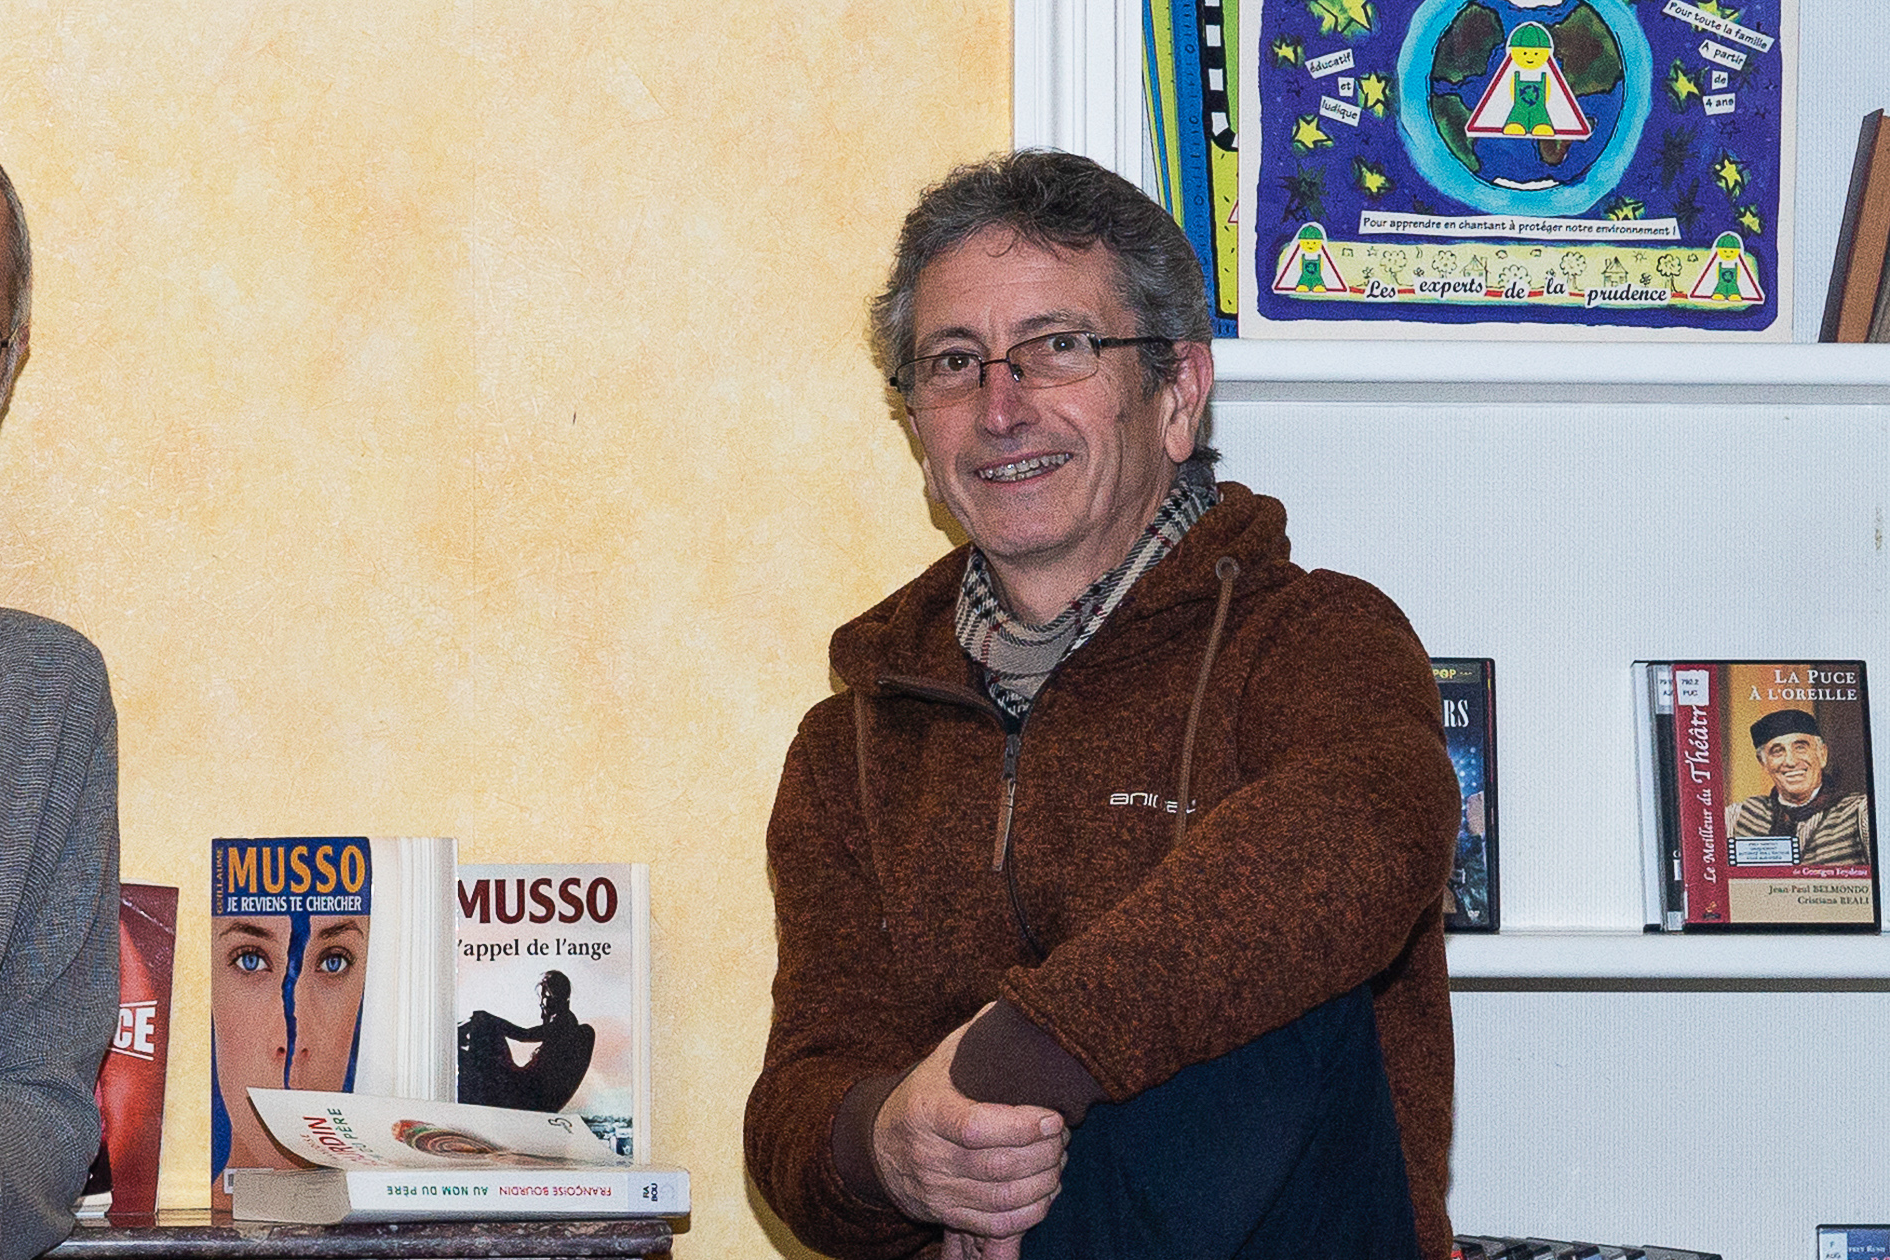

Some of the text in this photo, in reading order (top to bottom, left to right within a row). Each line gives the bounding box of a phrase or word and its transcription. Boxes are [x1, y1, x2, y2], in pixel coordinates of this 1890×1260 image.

[1669, 1, 1768, 50] Pour toute la famille
[1310, 52, 1351, 73] éducatif
[1713, 48, 1744, 65] partir
[1340, 82, 1352, 91] et
[1714, 74, 1727, 84] de
[1322, 99, 1358, 119] ludique
[1363, 217, 1387, 228] Pour
[1389, 218, 1441, 231] apprendre
[1444, 221, 1456, 229] en
[1459, 219, 1507, 230] chantant
[1509, 220, 1516, 230] à
[1518, 221, 1563, 234] protéger
[1565, 223, 1593, 233] notre
[1596, 225, 1671, 236] environnement
[1366, 278, 1667, 305] Les experts de la prudence
[1774, 669, 1857, 684] LA PUCE
[1749, 685, 1858, 701] À L'OREILLE
[1685, 704, 1717, 884] Le Meilleur du Théâtr
[227, 845, 366, 894] MUSSO
[1812, 885, 1869, 894] BELMONDO
[227, 895, 362, 913] JE REVIENS TE CHERCHER
[457, 876, 619, 925] MUSSO
[457, 938, 612, 962] 'appel de l'ange
[386, 1184, 612, 1198] FRANÇOISE BOURDIN AU NOM DU PÈRE
[650, 1183, 658, 1202] BOU
